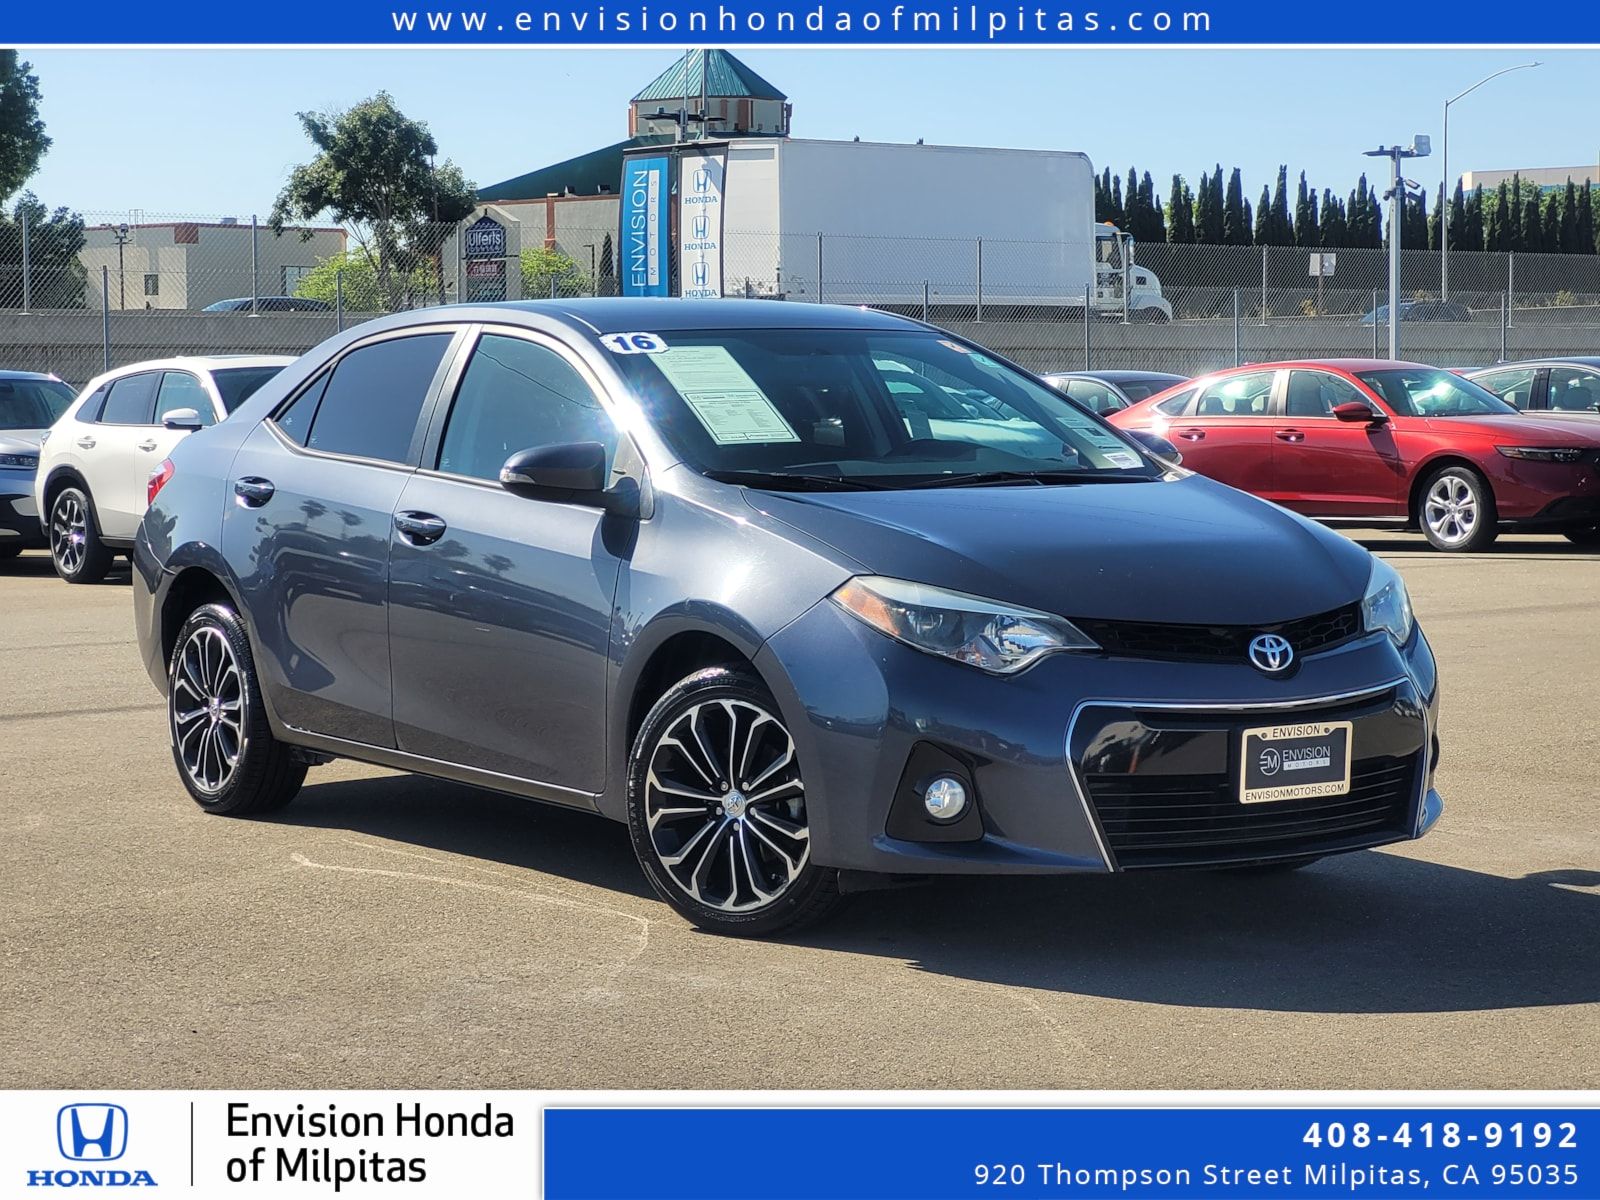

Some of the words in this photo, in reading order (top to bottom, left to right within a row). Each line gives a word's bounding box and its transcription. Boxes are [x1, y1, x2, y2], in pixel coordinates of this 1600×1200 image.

[684, 195, 718, 204] HONDA
[631, 170, 648, 287] ENVISION
[649, 180, 657, 276] MOTORS
[684, 242, 717, 251] HONDA
[685, 289, 718, 298] HONDA
[612, 335, 657, 351] 16
[1272, 725, 1321, 738] ENVISION
[1282, 746, 1331, 761] ENVISION
[1287, 759, 1328, 769] MOTORS
[1245, 783, 1345, 801] ENVISIONMOTORS.COM
